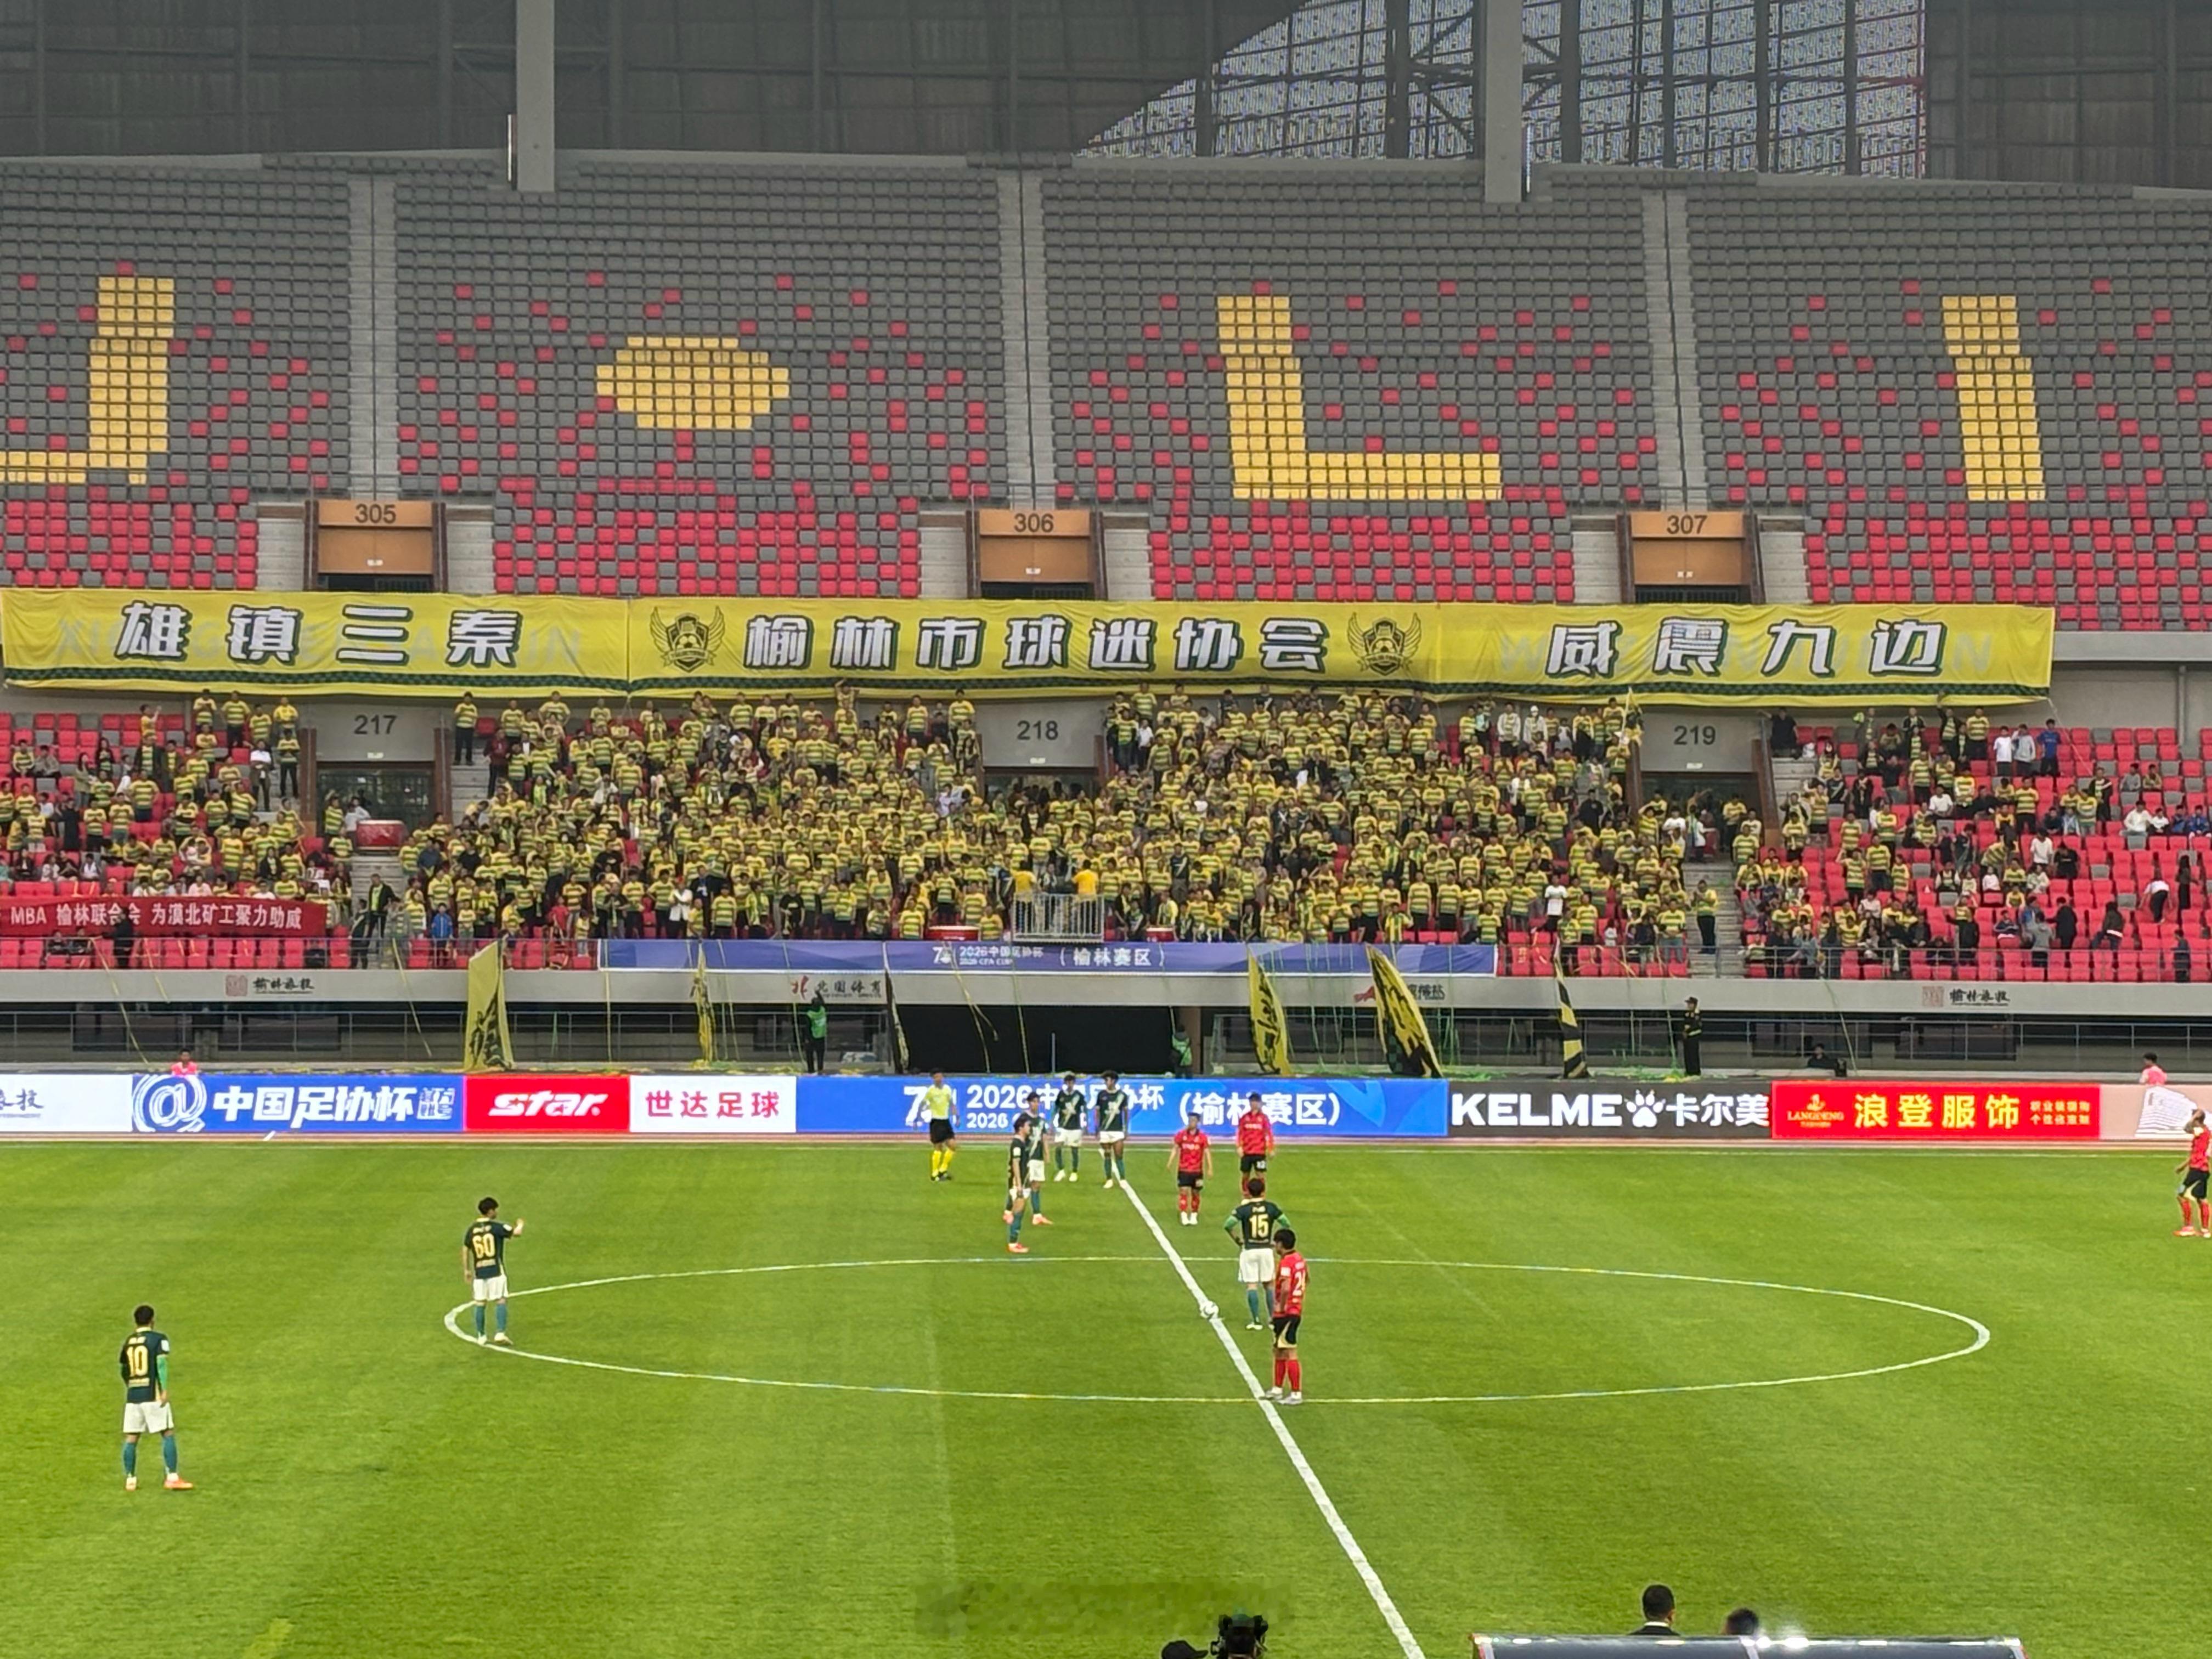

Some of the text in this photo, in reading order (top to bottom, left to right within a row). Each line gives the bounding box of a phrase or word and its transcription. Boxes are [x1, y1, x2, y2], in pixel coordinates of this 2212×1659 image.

[354, 504, 397, 524] 305
[1014, 513, 1054, 533] 306
[1666, 515, 1708, 534] 307
[114, 600, 524, 667] 雄镇三秦
[743, 614, 1330, 675] 榆林市球迷协会
[1544, 616, 1948, 679] 威震九边
[353, 714, 398, 735] 217
[1016, 719, 1059, 741] 218
[1673, 725, 1716, 746] 219
[10, 906, 47, 926] MBA
[645, 1090, 780, 1118] 世达足球
[1451, 1093, 1770, 1127] KELME 卡尔美
[1854, 1093, 2021, 1130] 浪登服饰
[1249, 1214, 1269, 1239] 15
[472, 1232, 495, 1259] 60
[127, 1345, 148, 1377] 10
